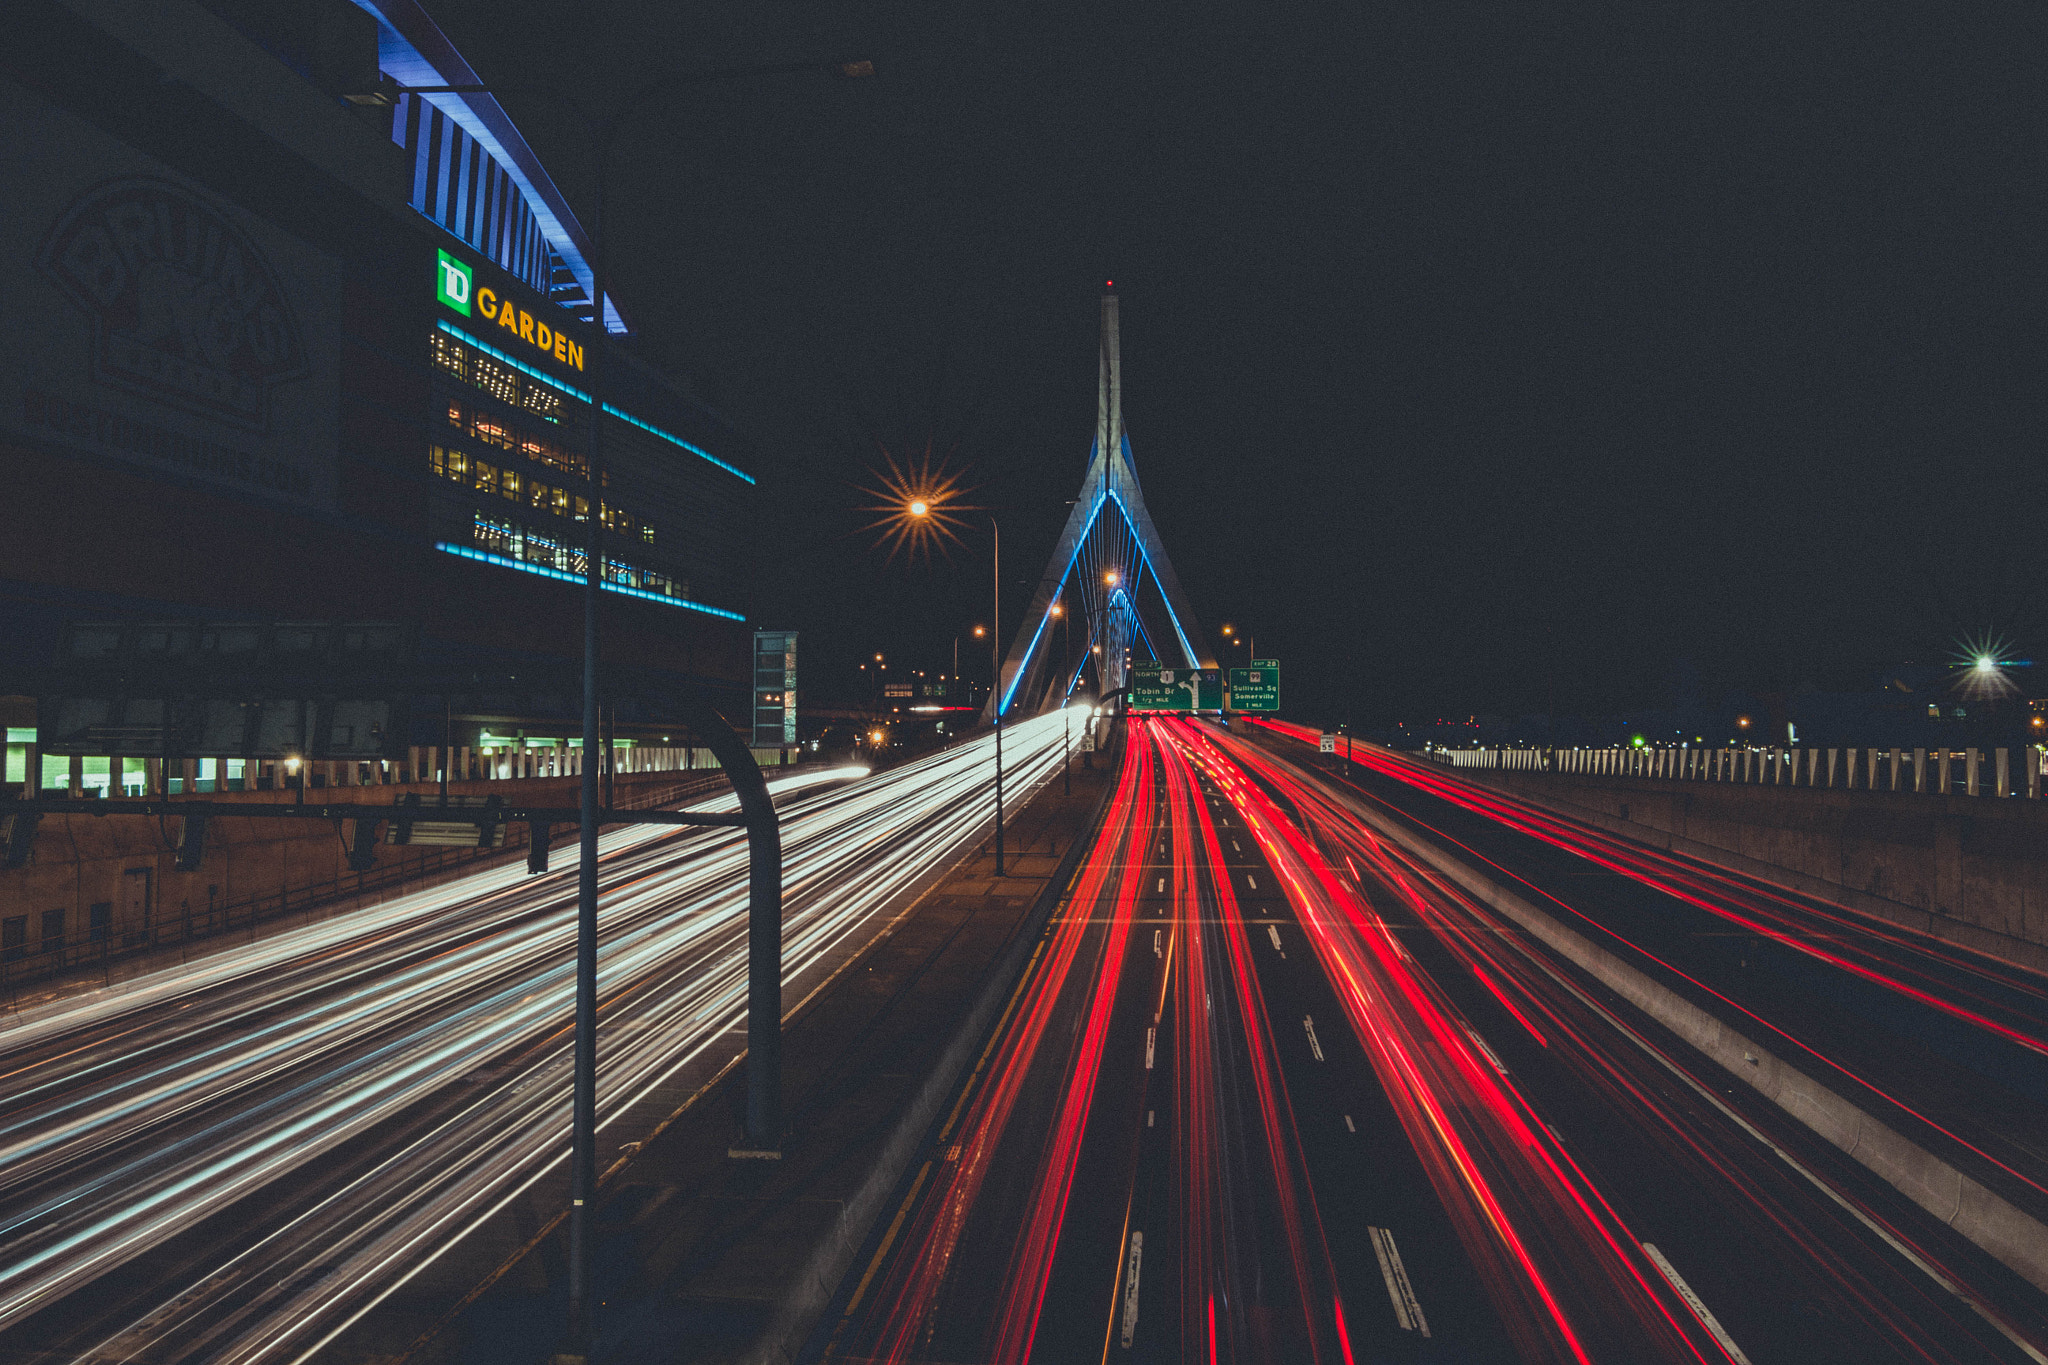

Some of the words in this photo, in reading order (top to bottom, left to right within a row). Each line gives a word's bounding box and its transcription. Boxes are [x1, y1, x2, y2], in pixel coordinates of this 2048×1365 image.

[61, 201, 290, 364] BRUINS
[441, 260, 469, 304] TD
[477, 287, 583, 372] GARDEN
[1136, 687, 1160, 695] Tobin
[1164, 687, 1175, 695] Br
[1251, 673, 1260, 681] 99
